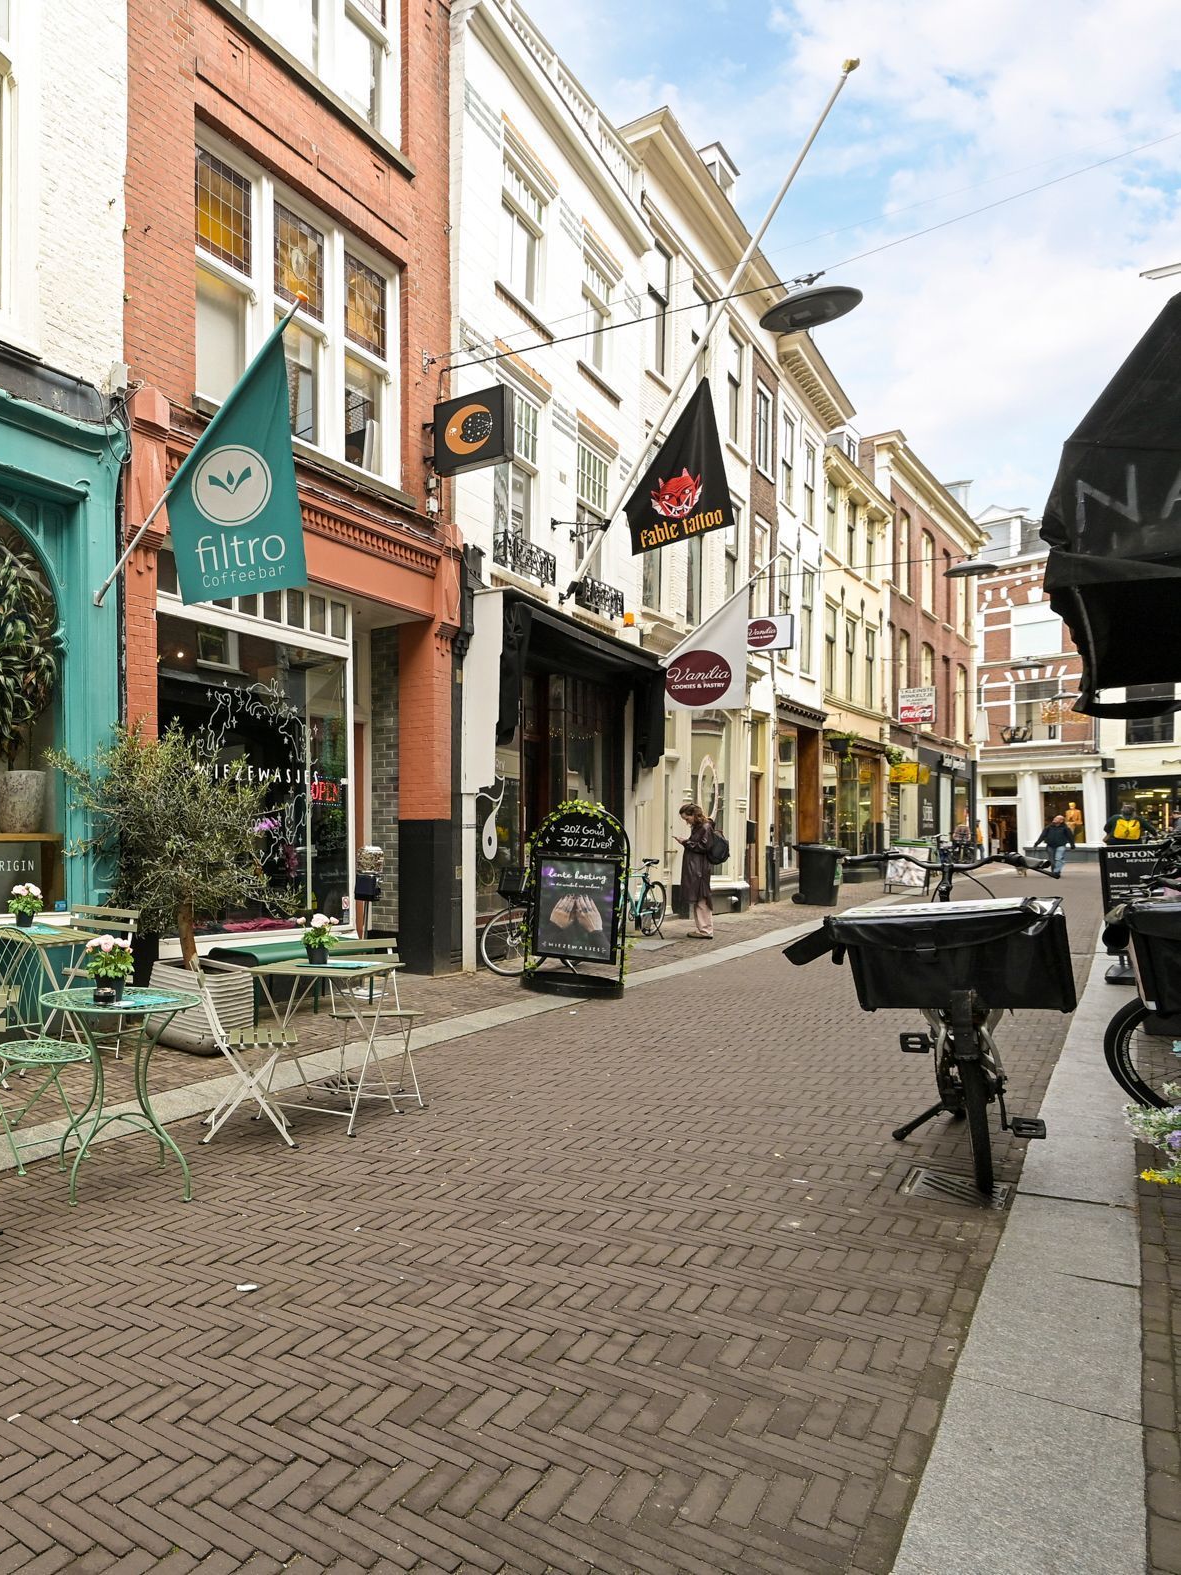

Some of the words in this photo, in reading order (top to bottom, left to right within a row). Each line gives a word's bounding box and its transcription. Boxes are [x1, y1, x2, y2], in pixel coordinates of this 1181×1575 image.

[683, 509, 723, 535] tattoo
[195, 533, 286, 573] filtro
[202, 565, 286, 588] Coffeebar
[666, 665, 730, 682] Vanilia
[311, 781, 339, 802] OPEN
[560, 825, 580, 834] -20%
[582, 826, 605, 837] Goud
[556, 837, 578, 847] -30%
[1107, 850, 1155, 859] BOSTON
